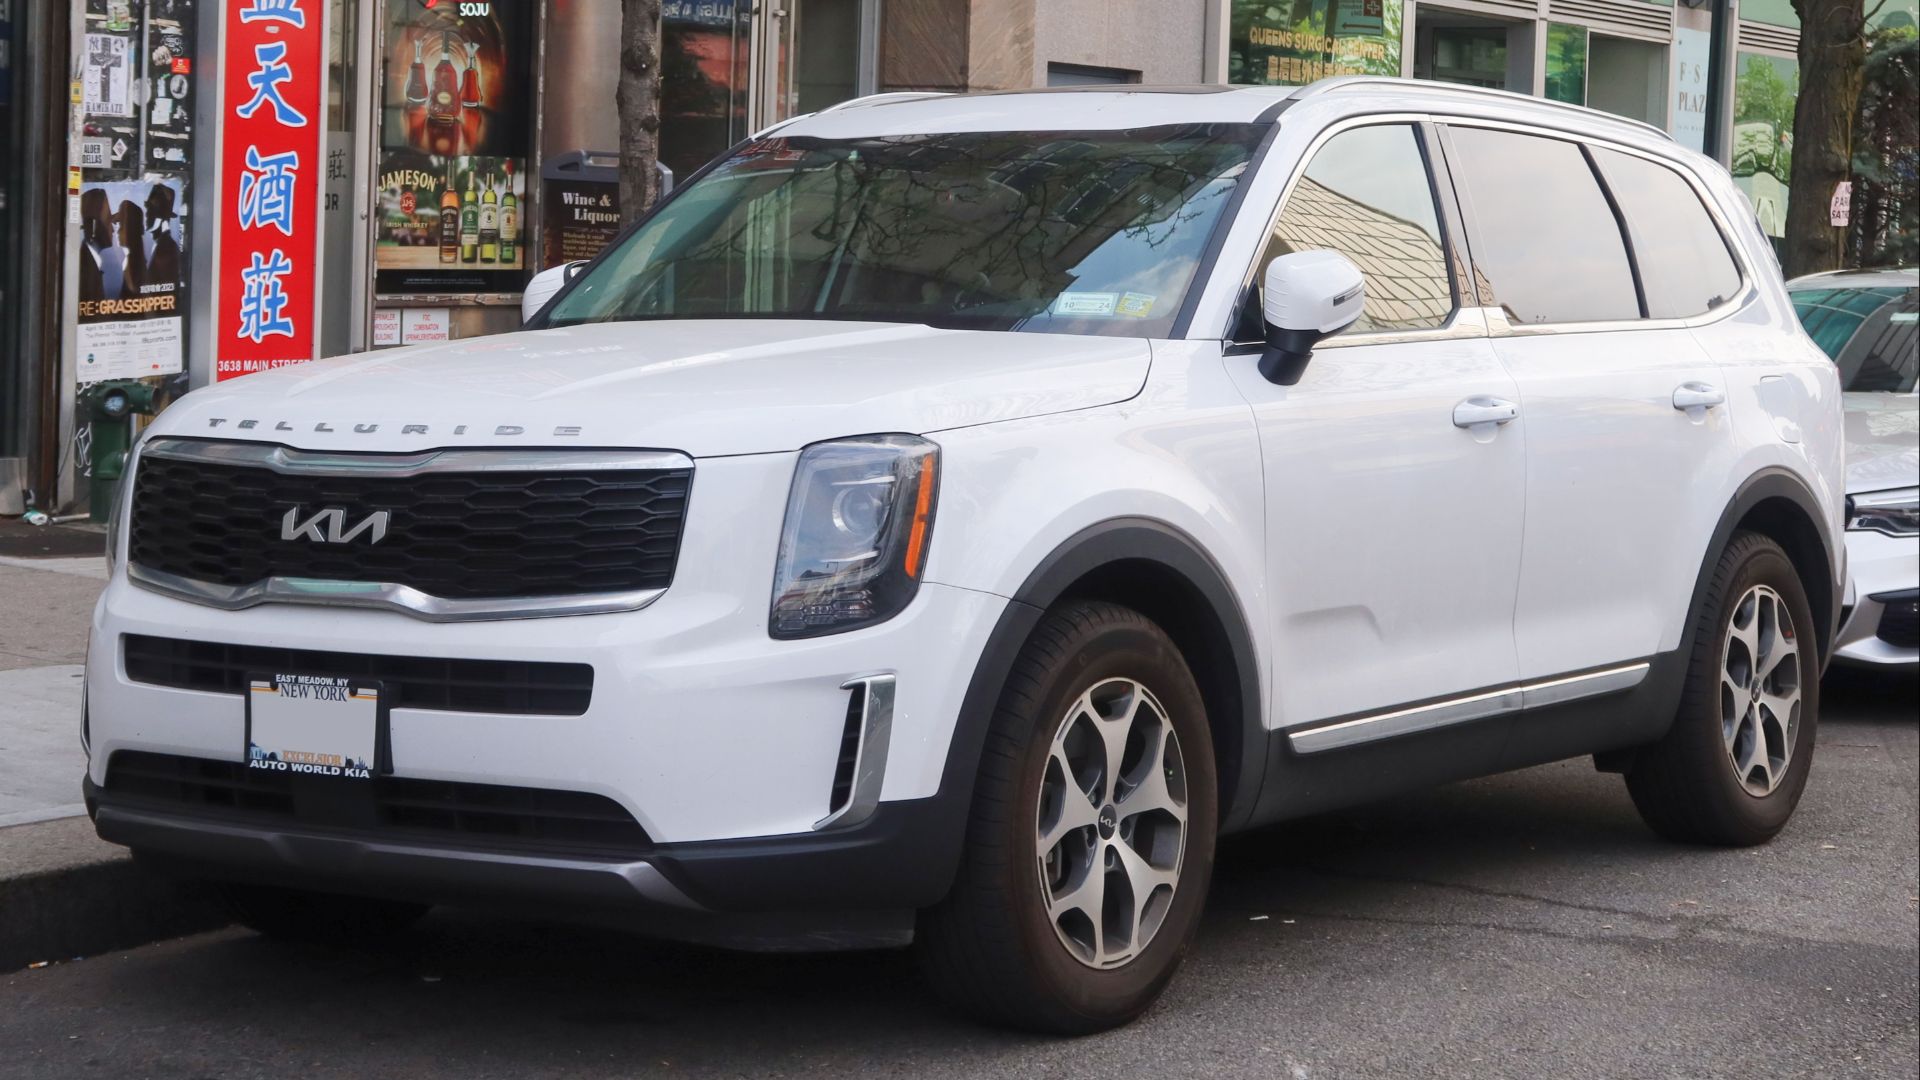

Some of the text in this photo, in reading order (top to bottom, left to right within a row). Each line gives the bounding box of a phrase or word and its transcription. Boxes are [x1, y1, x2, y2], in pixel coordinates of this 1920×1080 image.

[460, 3, 489, 16] SOJU
[1250, 26, 1385, 60] QUEENS SURGICAL CENTER
[1679, 91, 1706, 113] PLAZ
[380, 169, 437, 192] JAMESON
[563, 192, 611, 207] Wine &
[574, 208, 620, 224] Liquor
[218, 360, 241, 372] 3638
[243, 360, 269, 372] MAIN
[208, 417, 583, 436] TELLURIDE
[276, 674, 297, 683] EAST
[337, 678, 349, 687] NY
[281, 683, 348, 702] NEW YORK
[282, 750, 342, 767] EXCELSIOR
[250, 760, 370, 779] AUTO WORLD KIA
